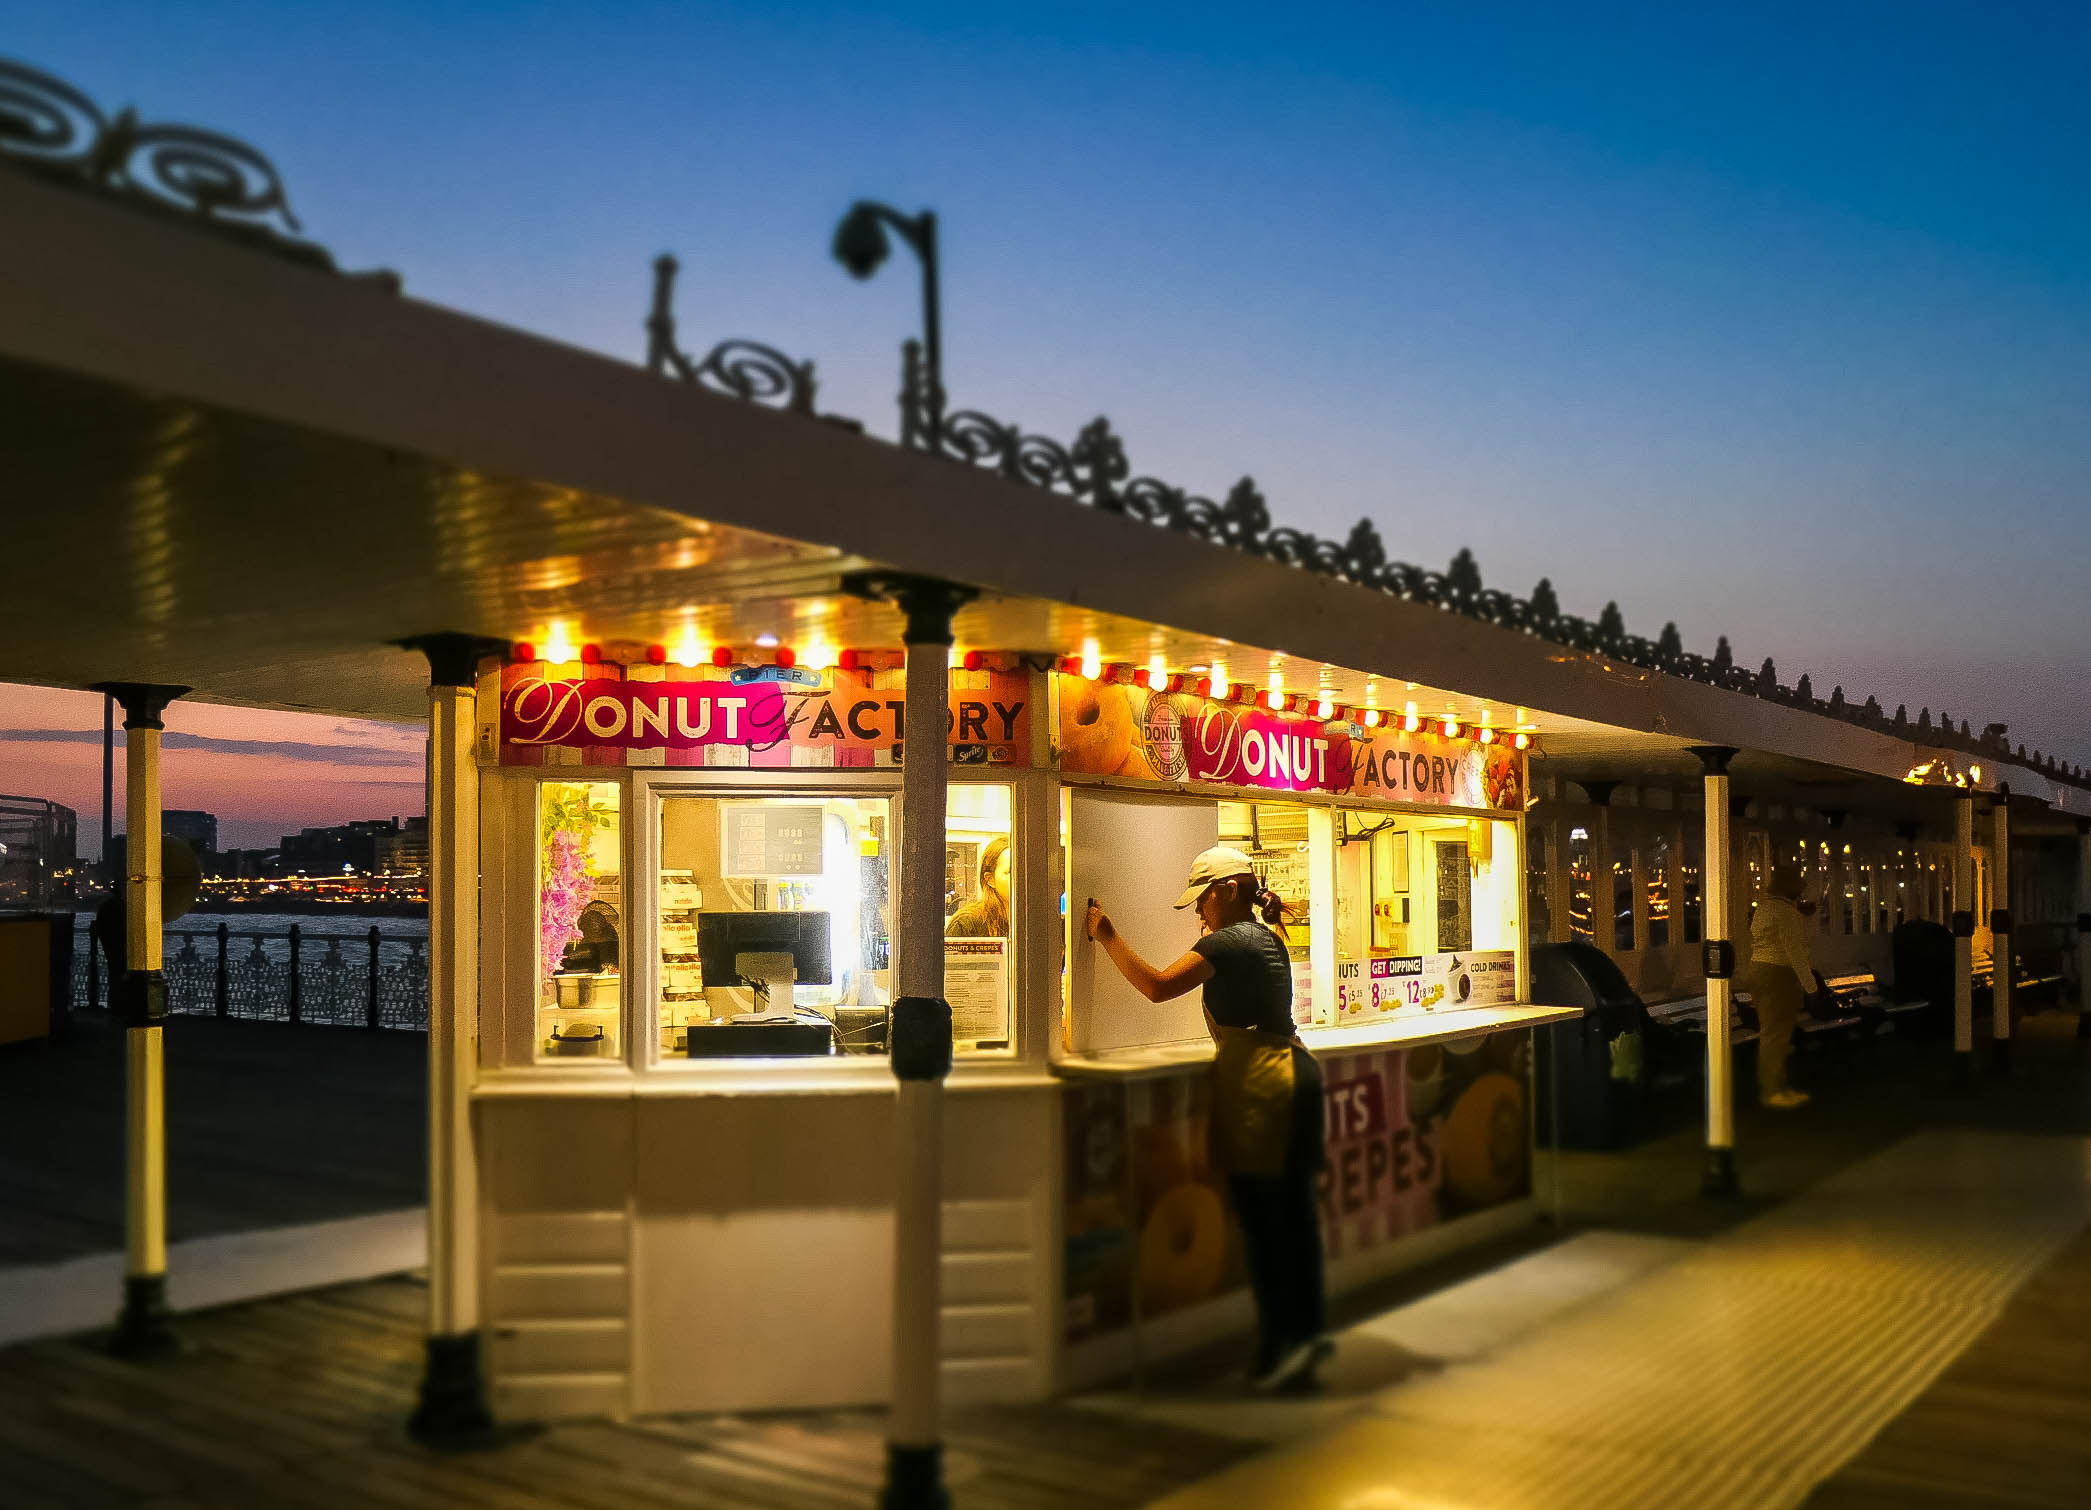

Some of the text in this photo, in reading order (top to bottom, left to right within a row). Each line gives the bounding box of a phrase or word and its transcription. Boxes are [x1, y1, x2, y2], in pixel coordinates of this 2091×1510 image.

[749, 669, 803, 681] PIER
[503, 676, 1025, 752] DONUT FACTRY
[959, 745, 984, 762] Sprite
[1194, 702, 1328, 783] DONUT
[1334, 737, 1458, 796] FACTORY
[1371, 961, 1387, 975] GET
[1389, 960, 1421, 974] DIPPING!
[1470, 961, 1511, 973] COLD DRINKS
[1339, 985, 1347, 1010] 5
[1371, 983, 1380, 1007] 8
[1407, 980, 1420, 1003] 12
